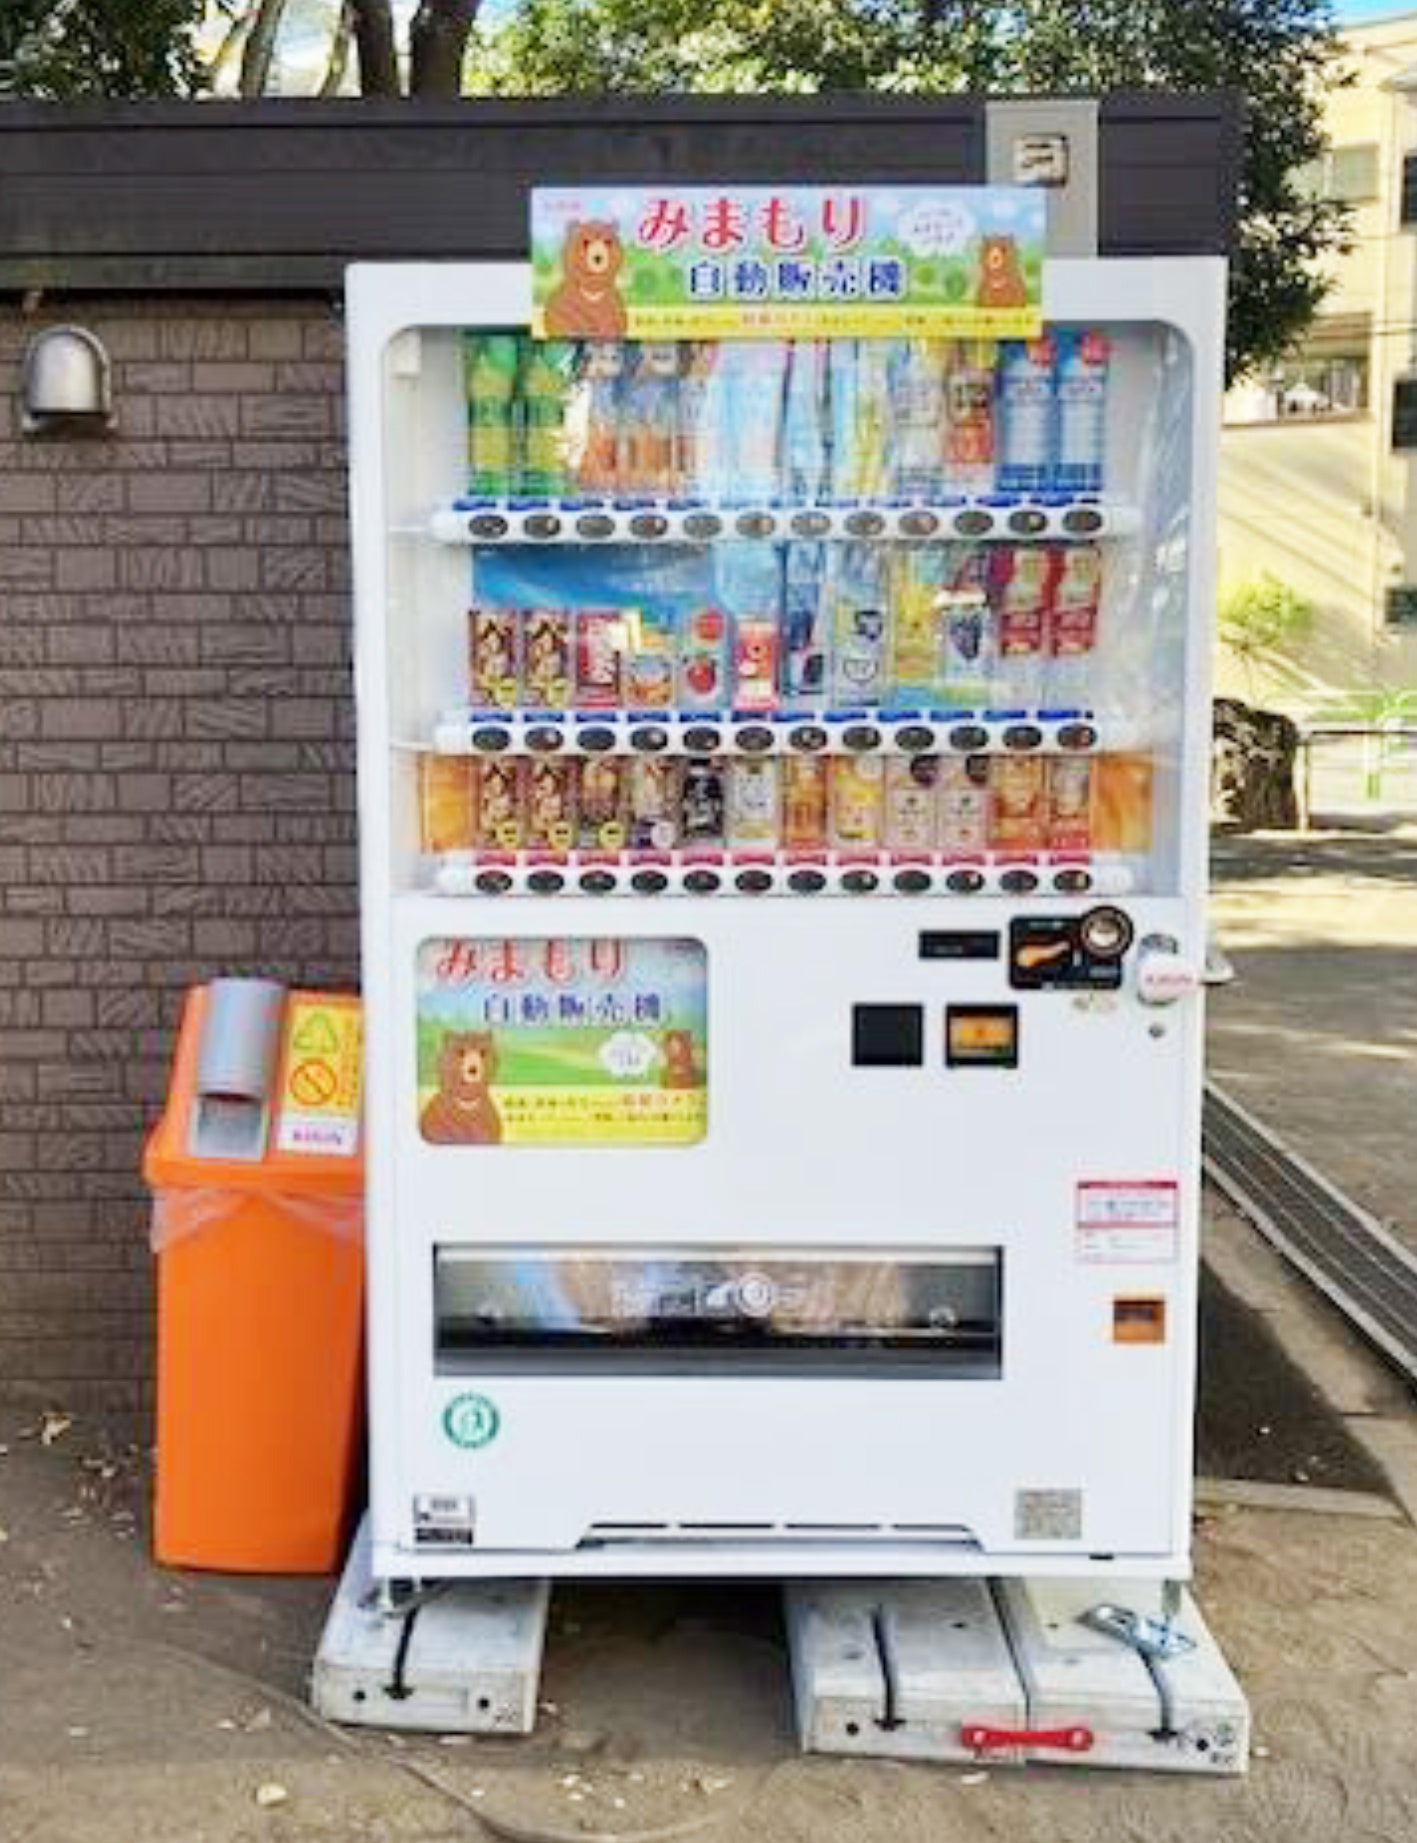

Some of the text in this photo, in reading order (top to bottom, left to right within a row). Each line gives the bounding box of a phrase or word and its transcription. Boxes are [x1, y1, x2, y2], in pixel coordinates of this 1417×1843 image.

[638, 196, 864, 250] みまもり
[689, 259, 903, 296] 自動販売機
